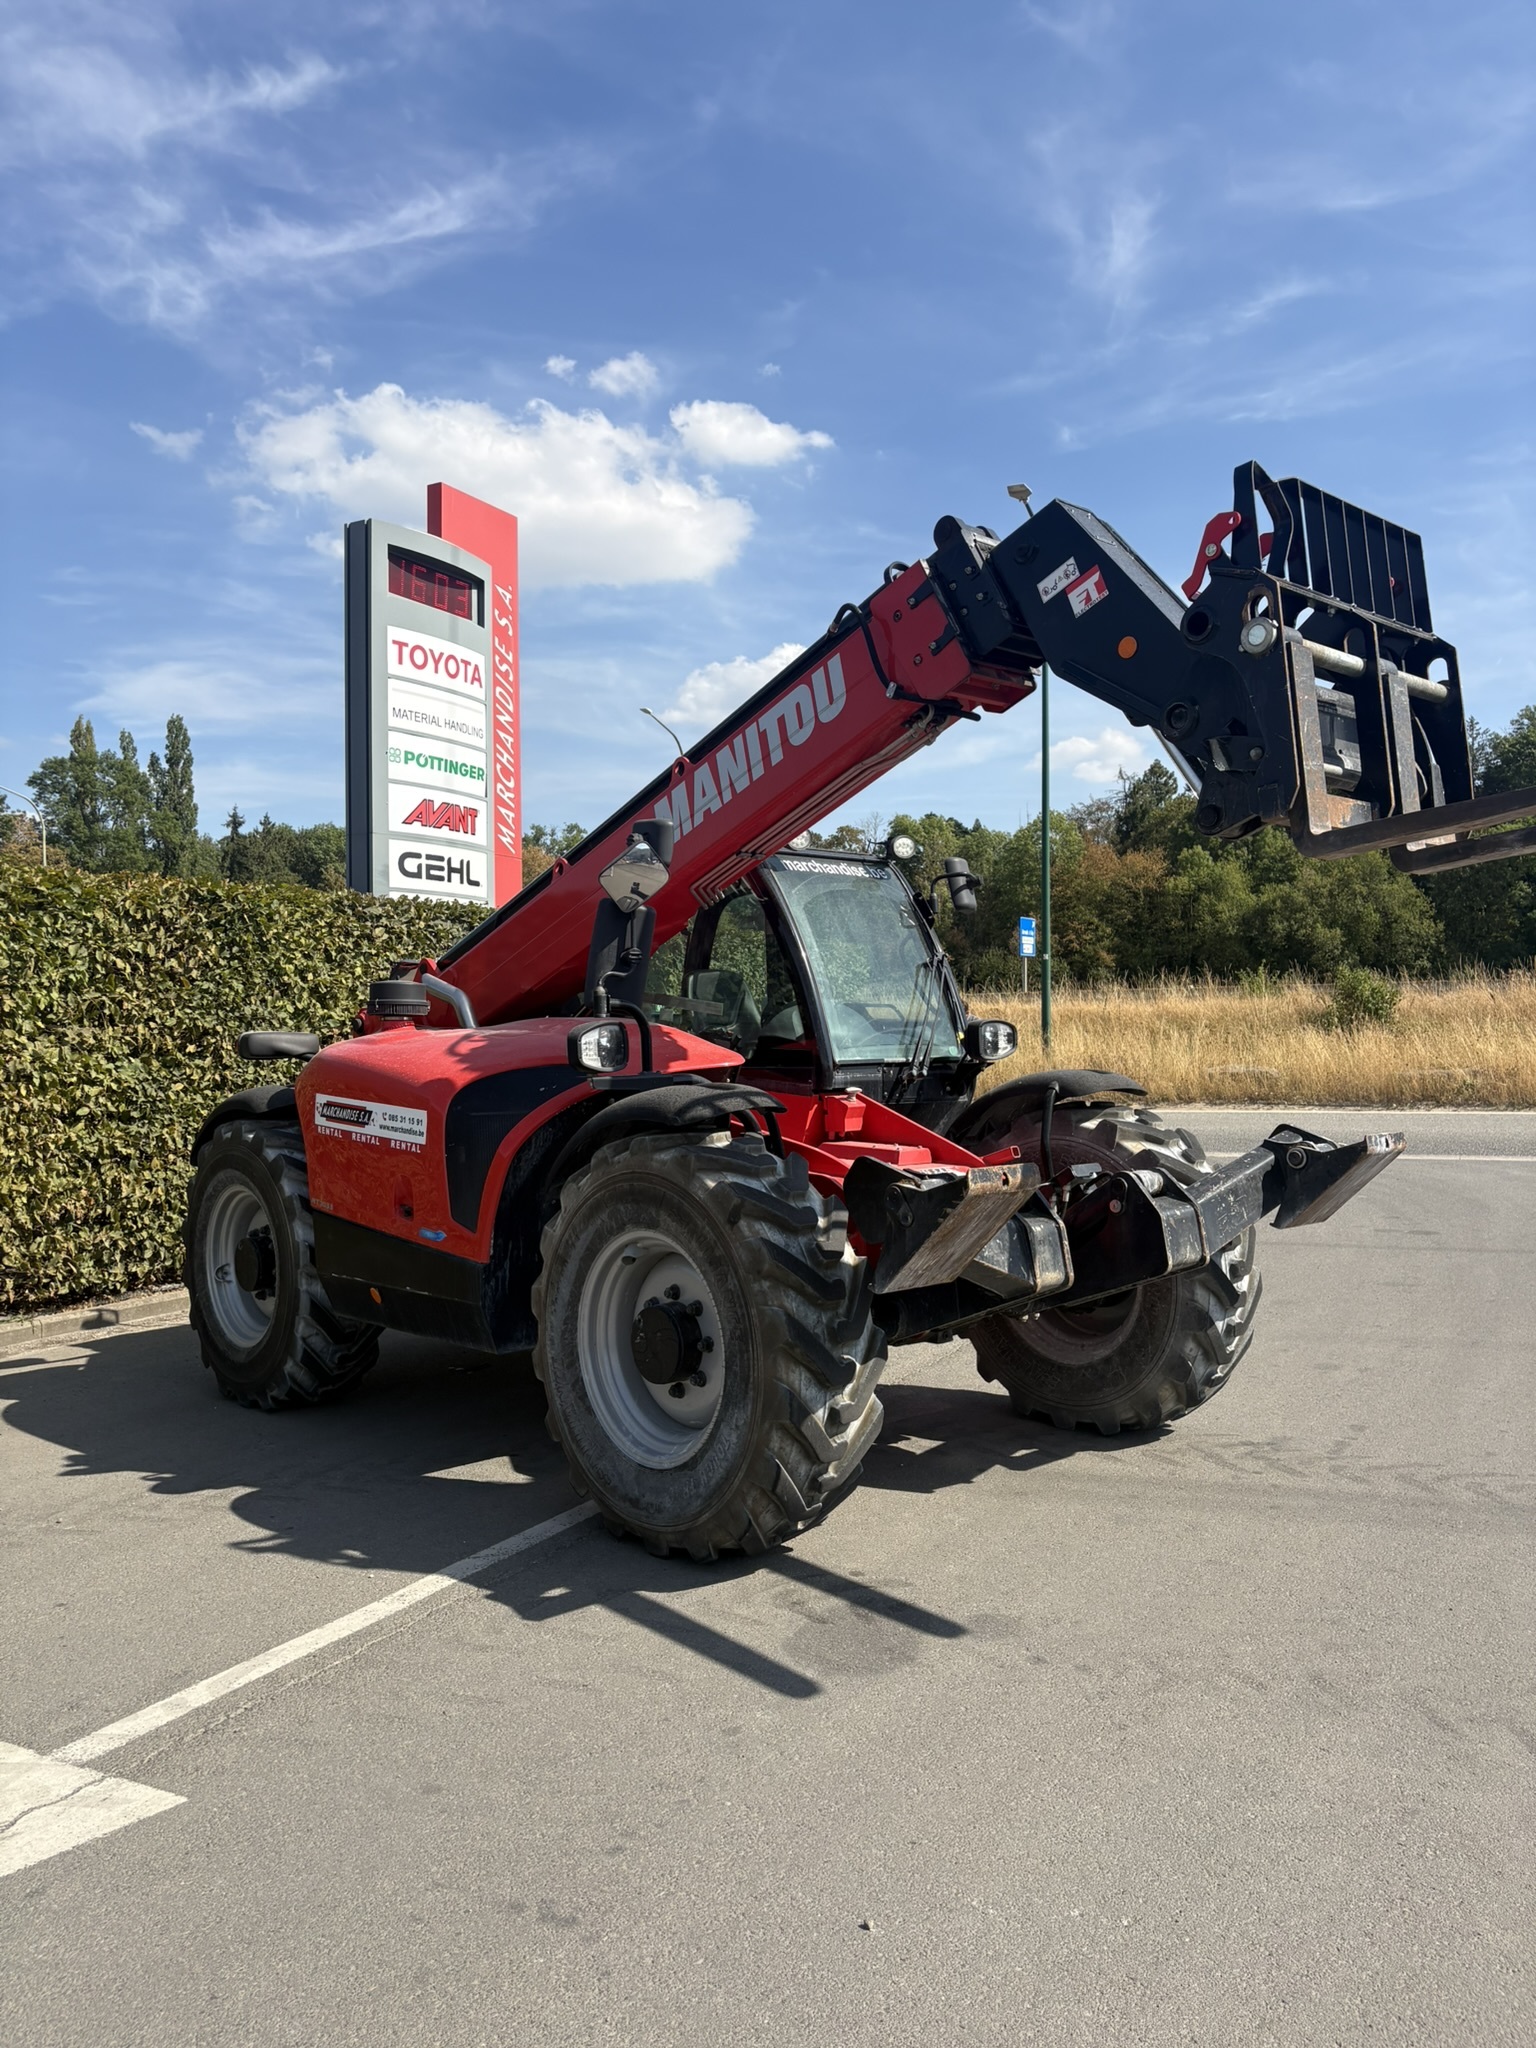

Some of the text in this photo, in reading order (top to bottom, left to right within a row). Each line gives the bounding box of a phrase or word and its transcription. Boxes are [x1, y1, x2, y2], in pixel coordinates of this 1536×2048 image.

[392, 639, 483, 689] TOYOTA
[392, 707, 484, 740] MATERIAL HANDLING
[494, 584, 516, 855] MARCHANDISE S.A.
[653, 652, 847, 844] MANITOU
[402, 798, 478, 836] AVANT
[398, 851, 481, 887] GEHL
[781, 859, 888, 879] marchandise.be
[322, 1105, 359, 1121] MARCHANDISE
[388, 1113, 423, 1126] 085 31 15 91
[318, 1126, 421, 1153] RENTAL RENTAL RENTAL
[379, 1123, 425, 1138] www.marchandise.be
